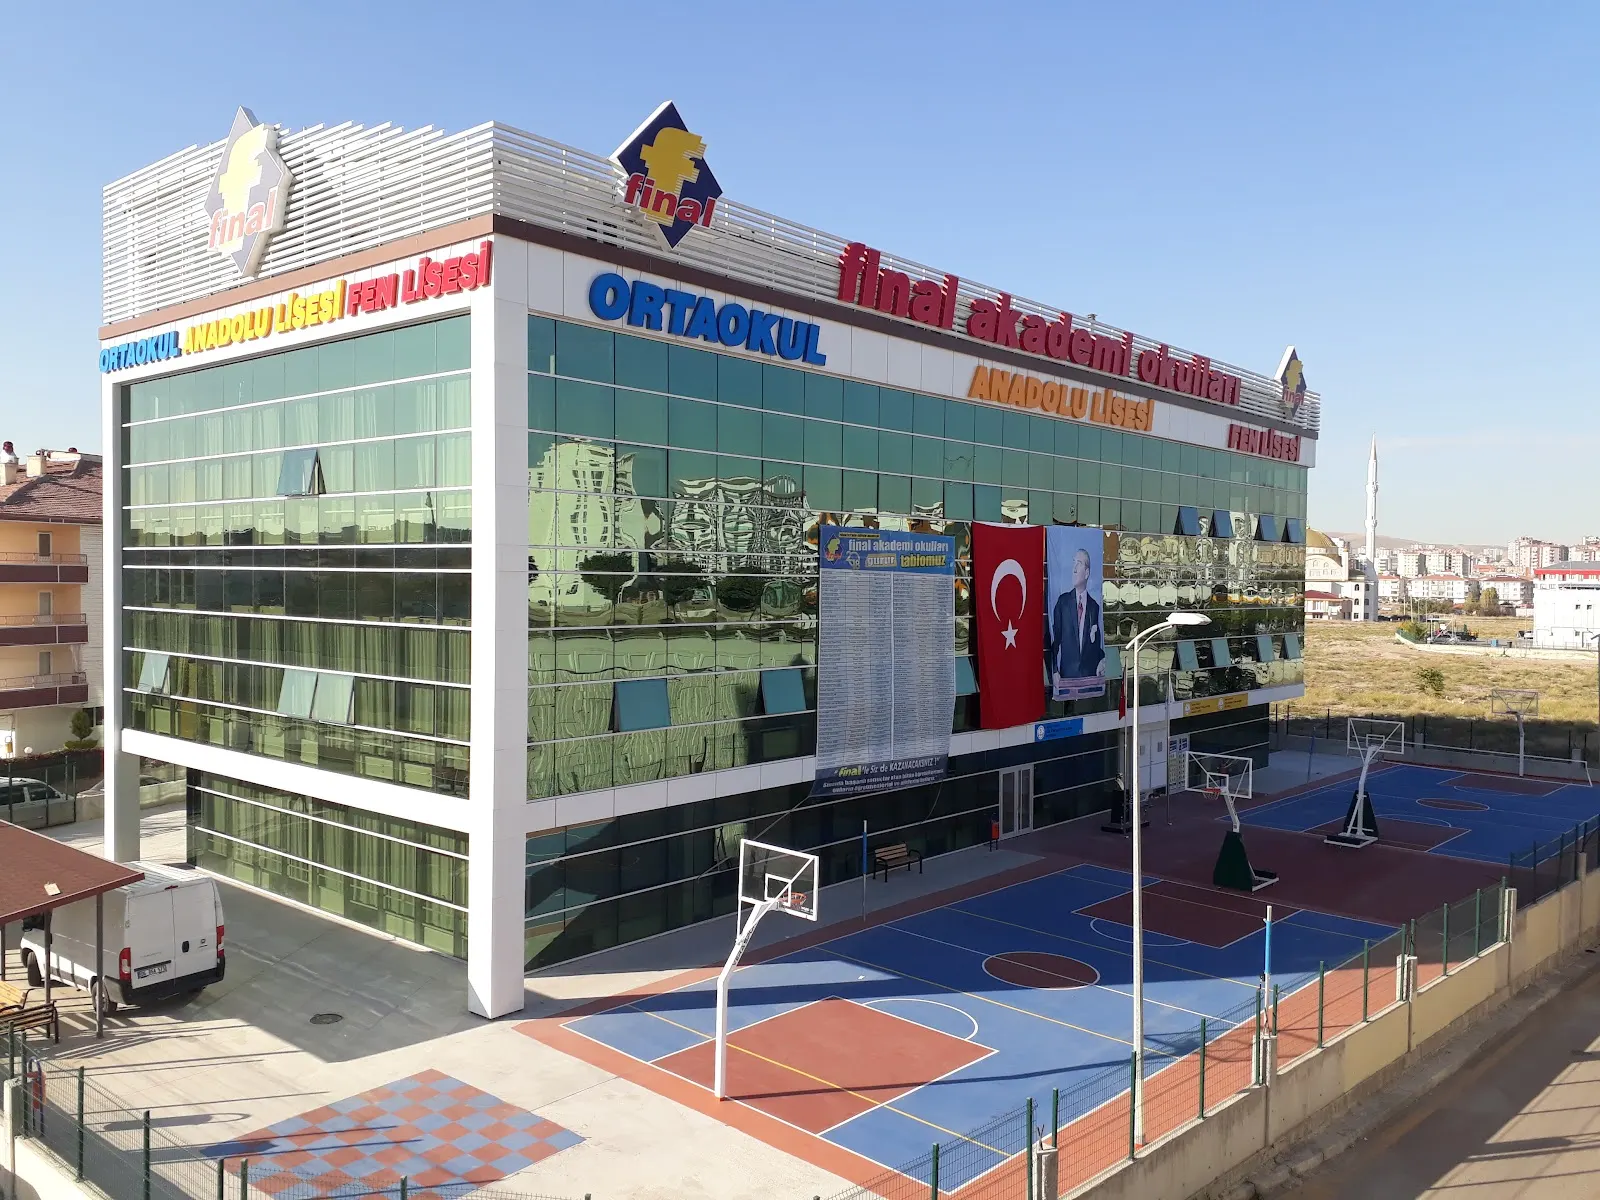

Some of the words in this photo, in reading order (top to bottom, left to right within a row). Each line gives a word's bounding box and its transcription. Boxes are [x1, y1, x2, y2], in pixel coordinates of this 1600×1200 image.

[208, 190, 275, 249] final
[624, 173, 717, 228] final
[100, 330, 182, 373] ORTAOKUL
[182, 304, 273, 354] ANADOLU
[273, 279, 347, 334] LİSESİ
[346, 273, 398, 317] FEN
[402, 241, 493, 303] LİSESİ
[589, 272, 827, 366] ORTAOKUL
[838, 242, 960, 330] final
[966, 291, 1133, 377] akademi
[1138, 343, 1241, 405] okulları
[968, 365, 1088, 419] ANADOLU
[1228, 424, 1260, 453] FEN
[848, 539, 872, 551] final
[873, 540, 913, 552] akademi
[867, 556, 895, 567] gurur
[900, 553, 946, 567] tablomuz
[838, 765, 862, 777] final
